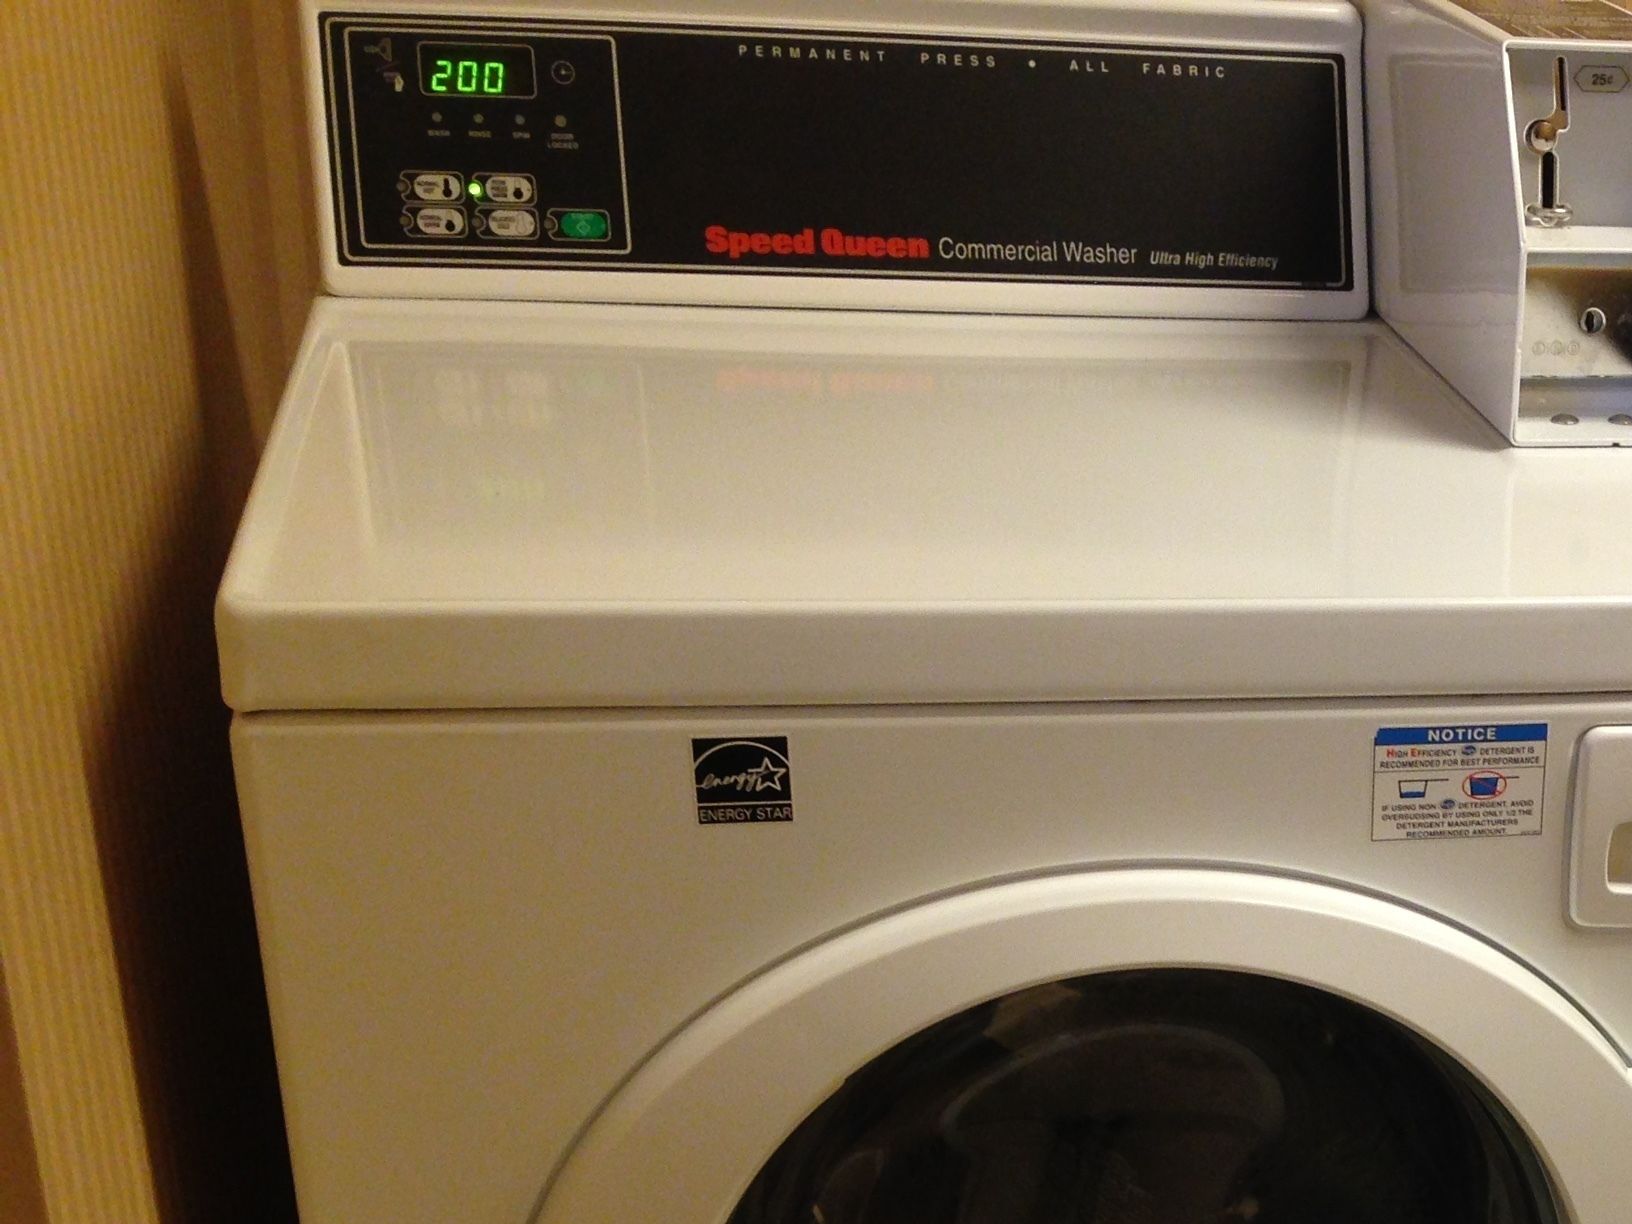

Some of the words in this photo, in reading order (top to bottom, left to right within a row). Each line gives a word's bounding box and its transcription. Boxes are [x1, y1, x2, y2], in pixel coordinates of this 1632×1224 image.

[738, 45, 886, 62] PERMANENT
[920, 52, 996, 68] PRESS
[1069, 59, 1109, 73] ALL
[1142, 63, 1225, 78] FABRIC
[431, 60, 504, 93] 200
[705, 225, 815, 258] Speed
[820, 228, 930, 258] Queen
[938, 237, 1057, 262] Commercial
[1062, 241, 1137, 264] Washer
[1150, 250, 1181, 265] Ultra
[1184, 252, 1214, 269] High
[1218, 252, 1279, 270] Efficiency
[1427, 727, 1497, 742] NOTICE
[1479, 747, 1526, 756] DETERGENT
[1527, 746, 1535, 754] IS
[1380, 759, 1441, 769] RECOMMENDED
[1442, 759, 1459, 767] FOR
[1460, 758, 1480, 767] BEST
[1482, 756, 1540, 765] PERFORMANCE
[700, 808, 753, 821] ENERGY
[756, 807, 792, 820] STAR
